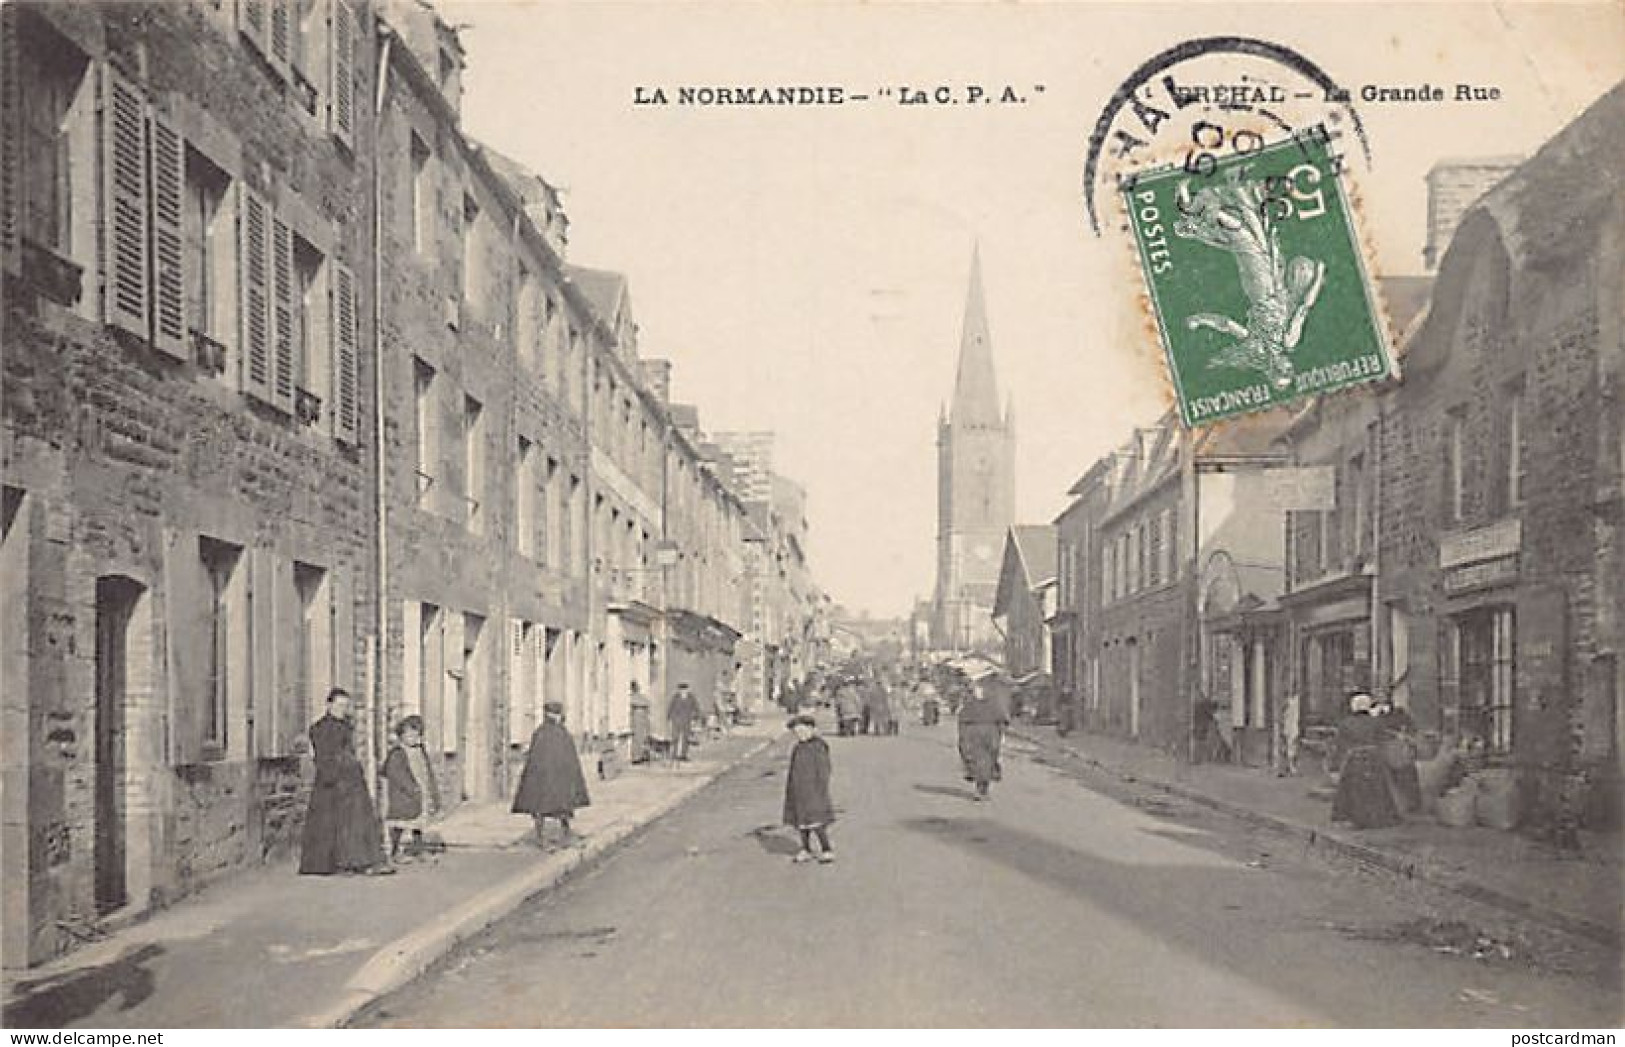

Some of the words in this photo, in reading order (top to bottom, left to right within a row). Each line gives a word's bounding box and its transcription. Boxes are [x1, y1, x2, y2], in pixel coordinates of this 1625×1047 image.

[633, 87, 667, 105] LA
[678, 87, 844, 105] NORMANDIE
[1361, 84, 1444, 102] Grande
[1454, 84, 1501, 101] Rue
[1135, 191, 1173, 275] POSTES
